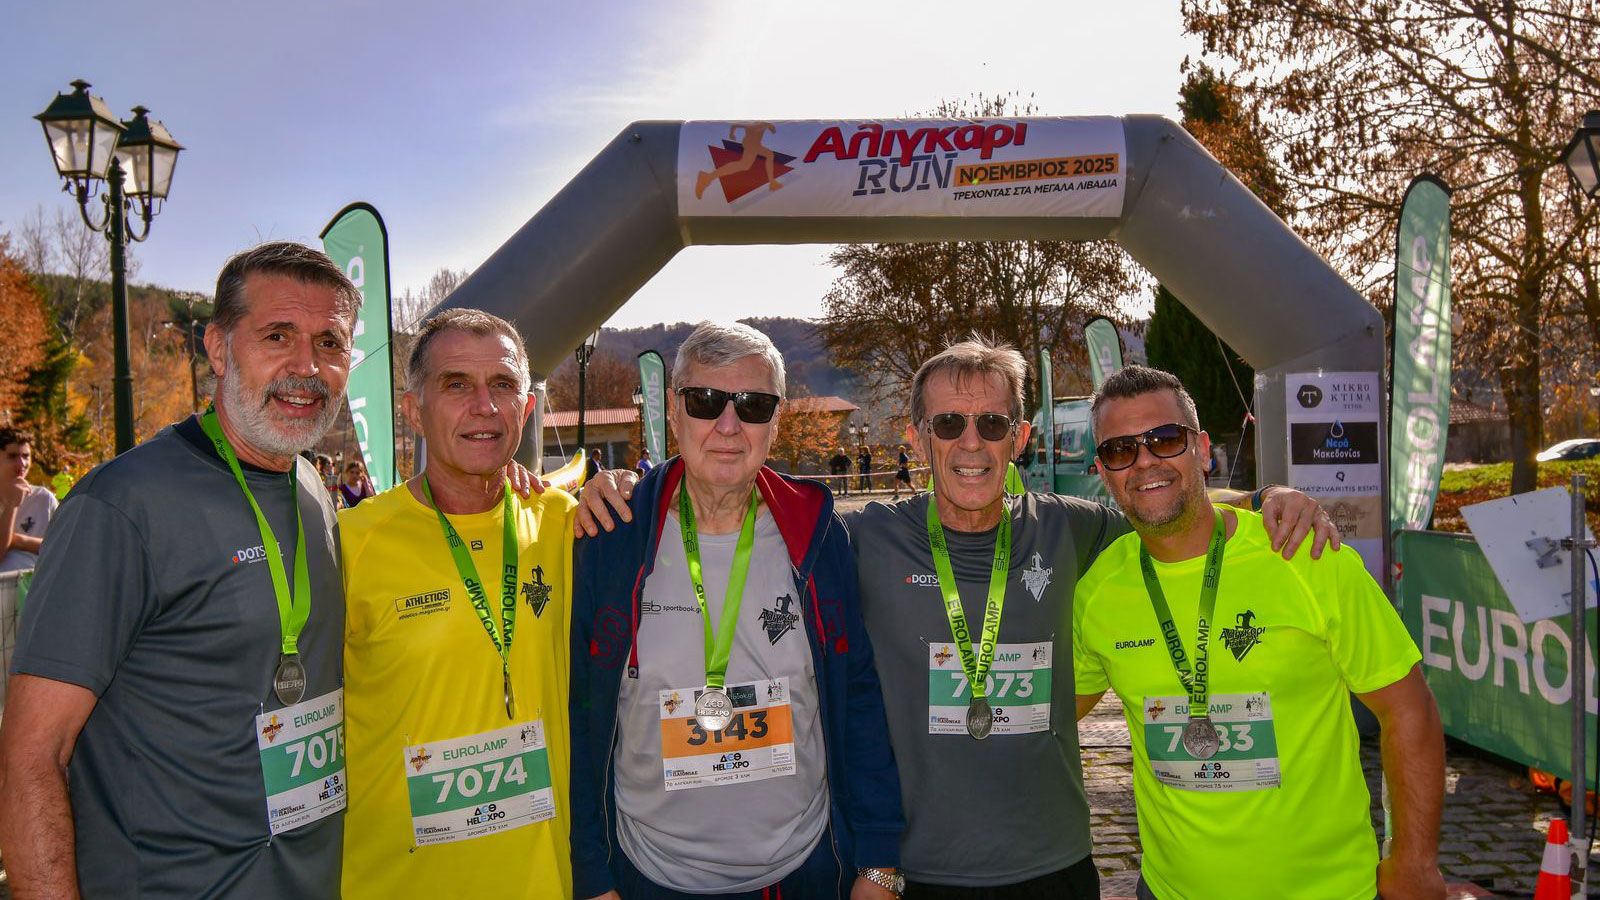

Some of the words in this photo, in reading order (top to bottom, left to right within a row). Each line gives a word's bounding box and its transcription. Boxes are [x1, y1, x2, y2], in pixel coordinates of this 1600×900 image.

[853, 152, 958, 196] RUN
[960, 161, 1068, 183] ΝΟΕΜΒΡΙΟΣ
[1073, 157, 1114, 175] 2025
[953, 188, 1011, 200] ΤΡΕΧΟΝΤΑΣ
[1013, 186, 1031, 196] ΣΤΑ
[1034, 182, 1074, 194] ΜΕΓΑΛΑ
[1076, 179, 1118, 191] ΛΙΒΑΔΙΑ
[405, 591, 449, 608] ATHLETICS
[976, 600, 1000, 683] EUROLAMP
[1115, 639, 1155, 650] EUROLAMP
[1193, 617, 1210, 704] EUROLAMP
[293, 704, 336, 728] EUROLAMP
[1175, 704, 1232, 715] EUAMP
[442, 738, 508, 761] EUROLAMP
[1163, 724, 1254, 753] 783
[712, 760, 750, 771] HELEXPO
[1194, 771, 1230, 779] HELEXPO
[432, 756, 528, 804] 7074
[466, 811, 506, 826] HELEXPO
